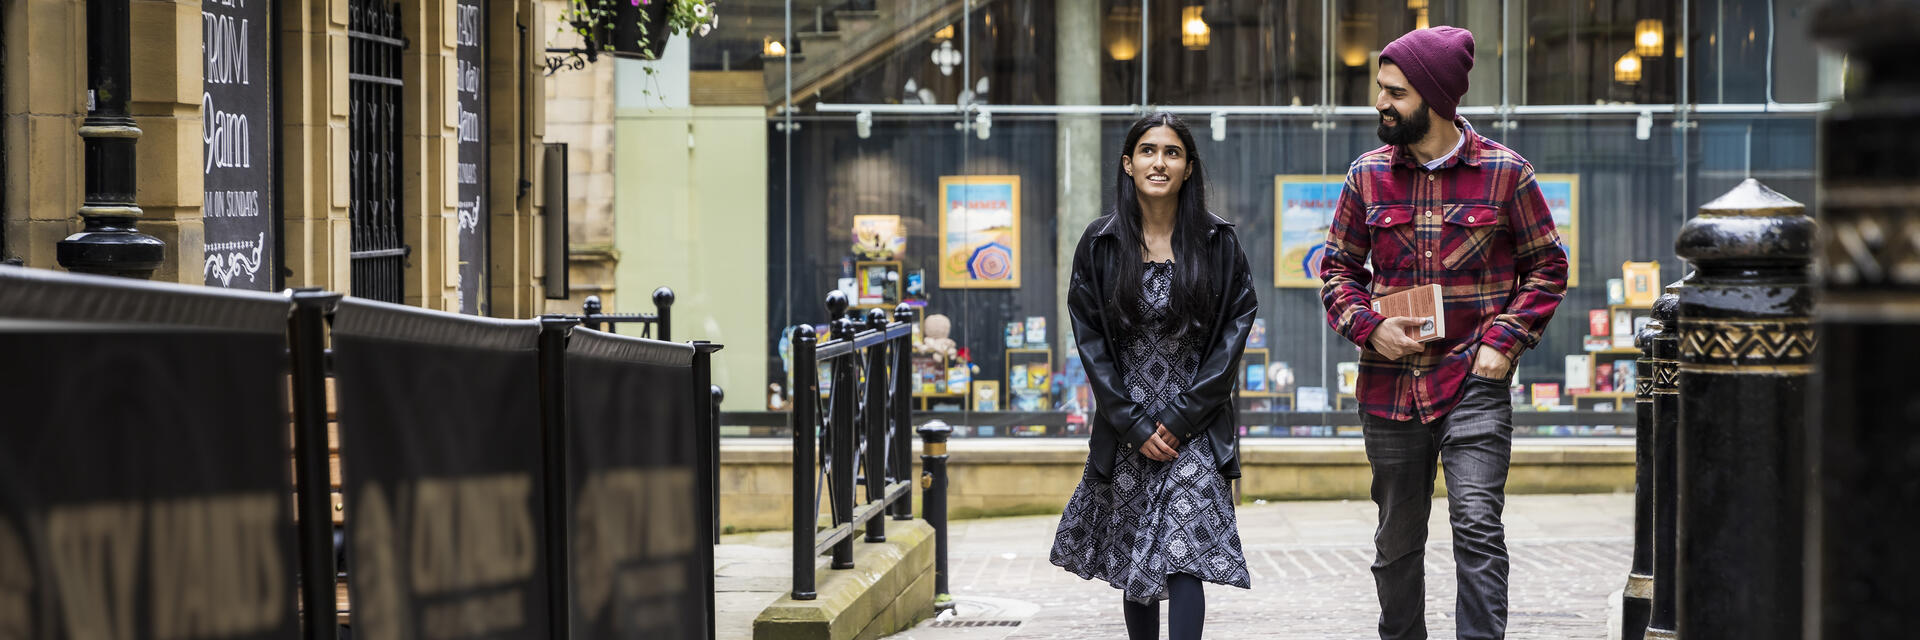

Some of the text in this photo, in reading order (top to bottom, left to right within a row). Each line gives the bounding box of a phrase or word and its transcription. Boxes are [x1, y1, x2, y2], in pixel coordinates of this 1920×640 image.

[465, 61, 480, 100] day
[203, 92, 250, 173] 9am
[214, 191, 225, 217] ON
[226, 190, 259, 217] SUNDAYS
